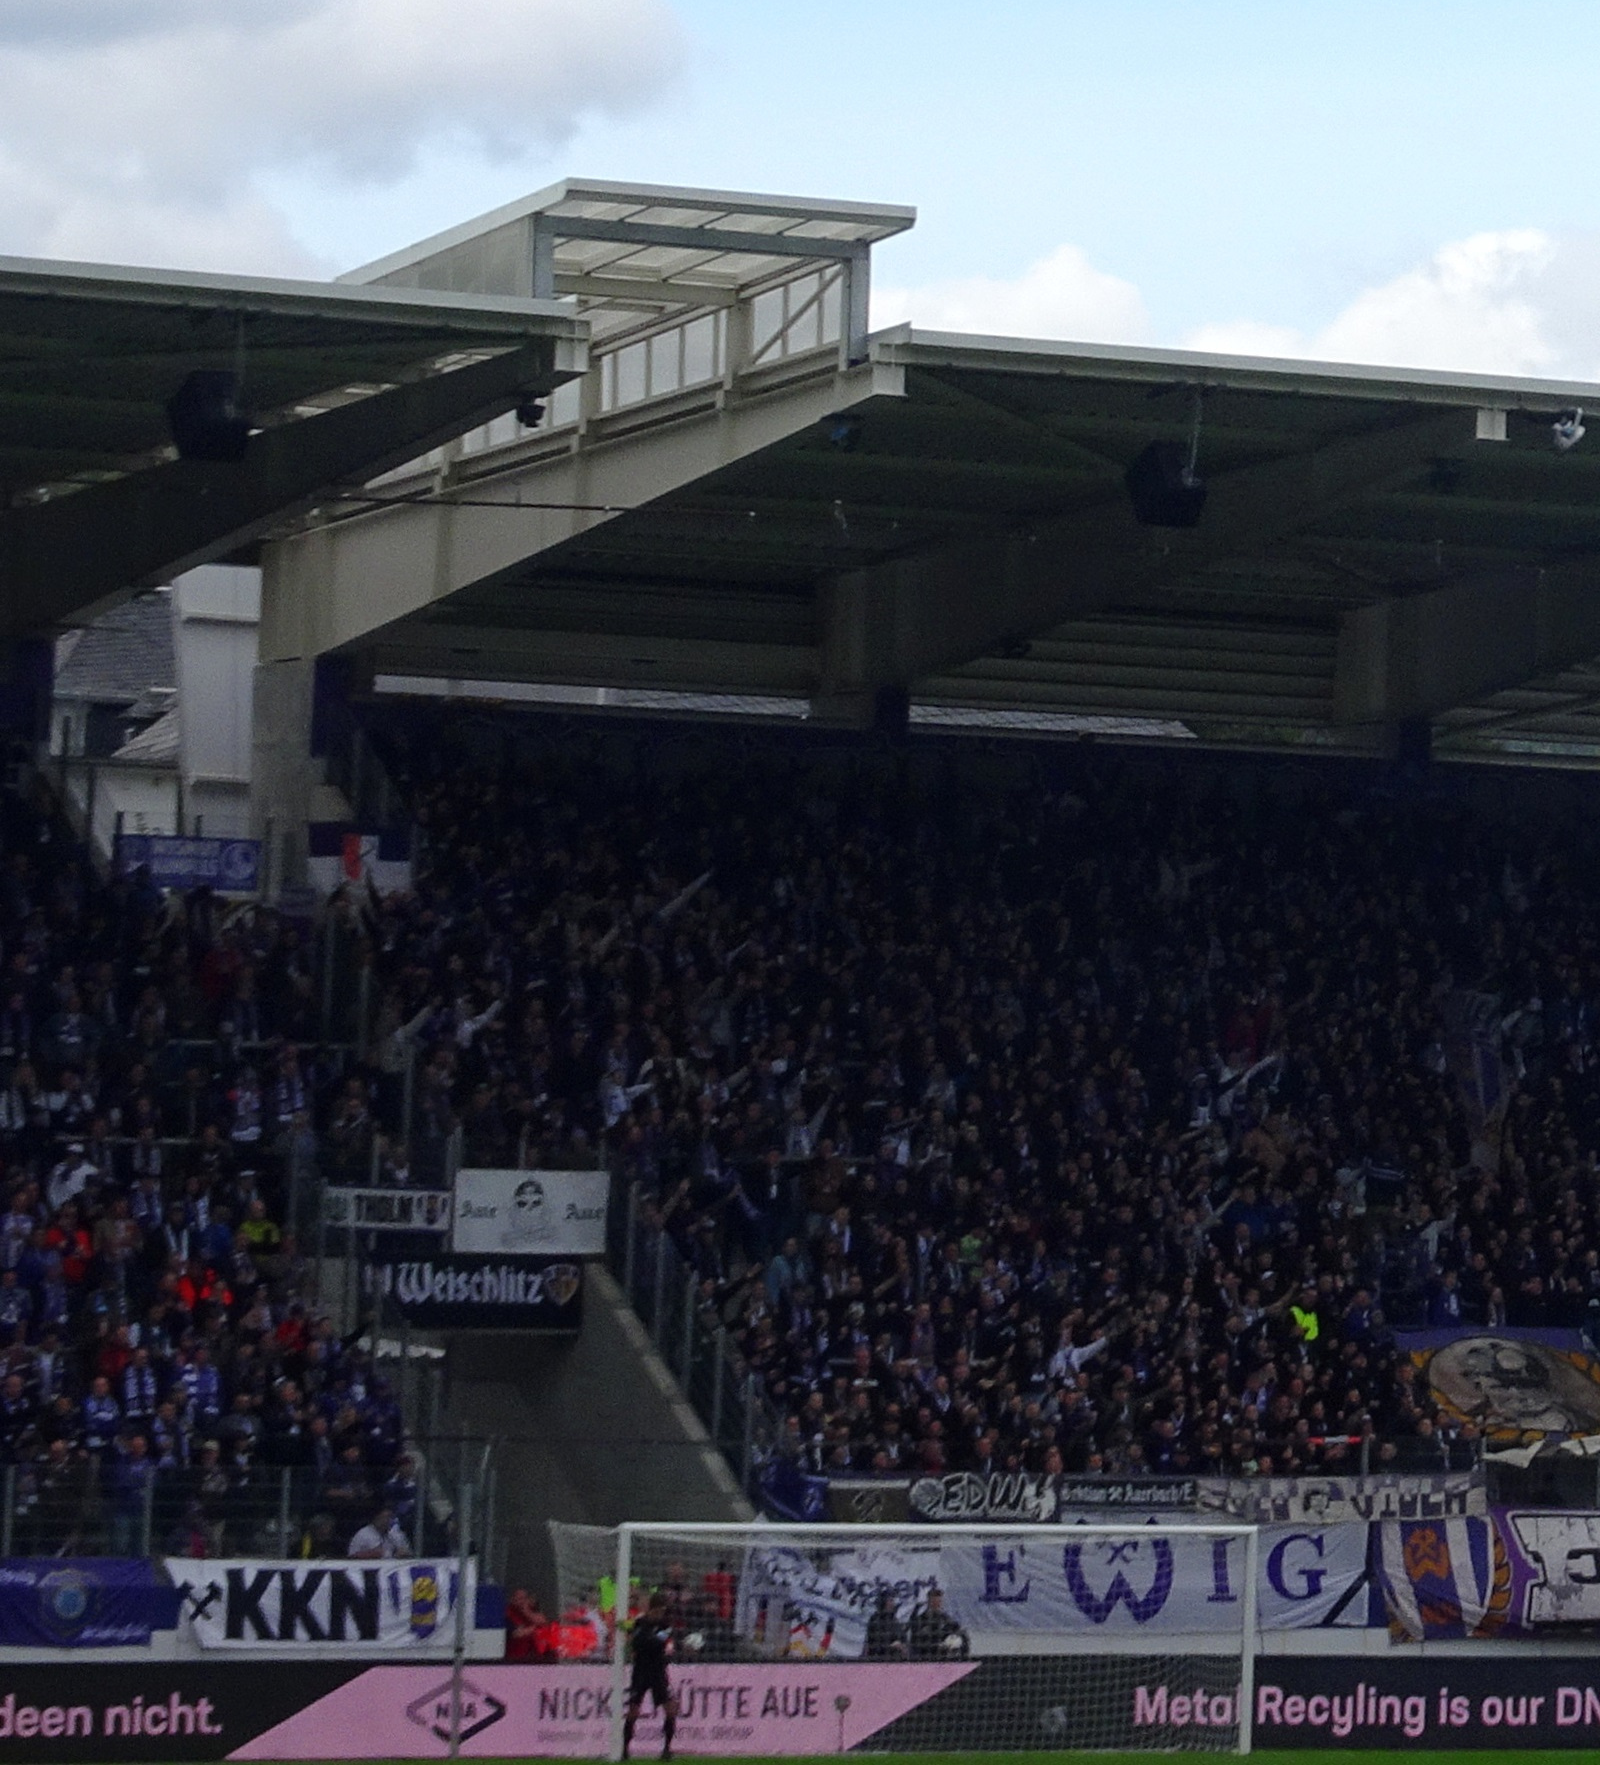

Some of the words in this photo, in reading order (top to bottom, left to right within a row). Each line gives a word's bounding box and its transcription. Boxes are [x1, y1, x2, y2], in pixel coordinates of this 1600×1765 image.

[396, 1262, 546, 1304] Weischlitz
[225, 1568, 380, 1640] KKN
[103, 1690, 223, 1737] nicht.
[435, 1701, 477, 1721] NA
[760, 1685, 819, 1718] AUE
[1257, 1682, 1427, 1736] Recyling
[1438, 1686, 1470, 1725] is
[1481, 1693, 1546, 1726] our
